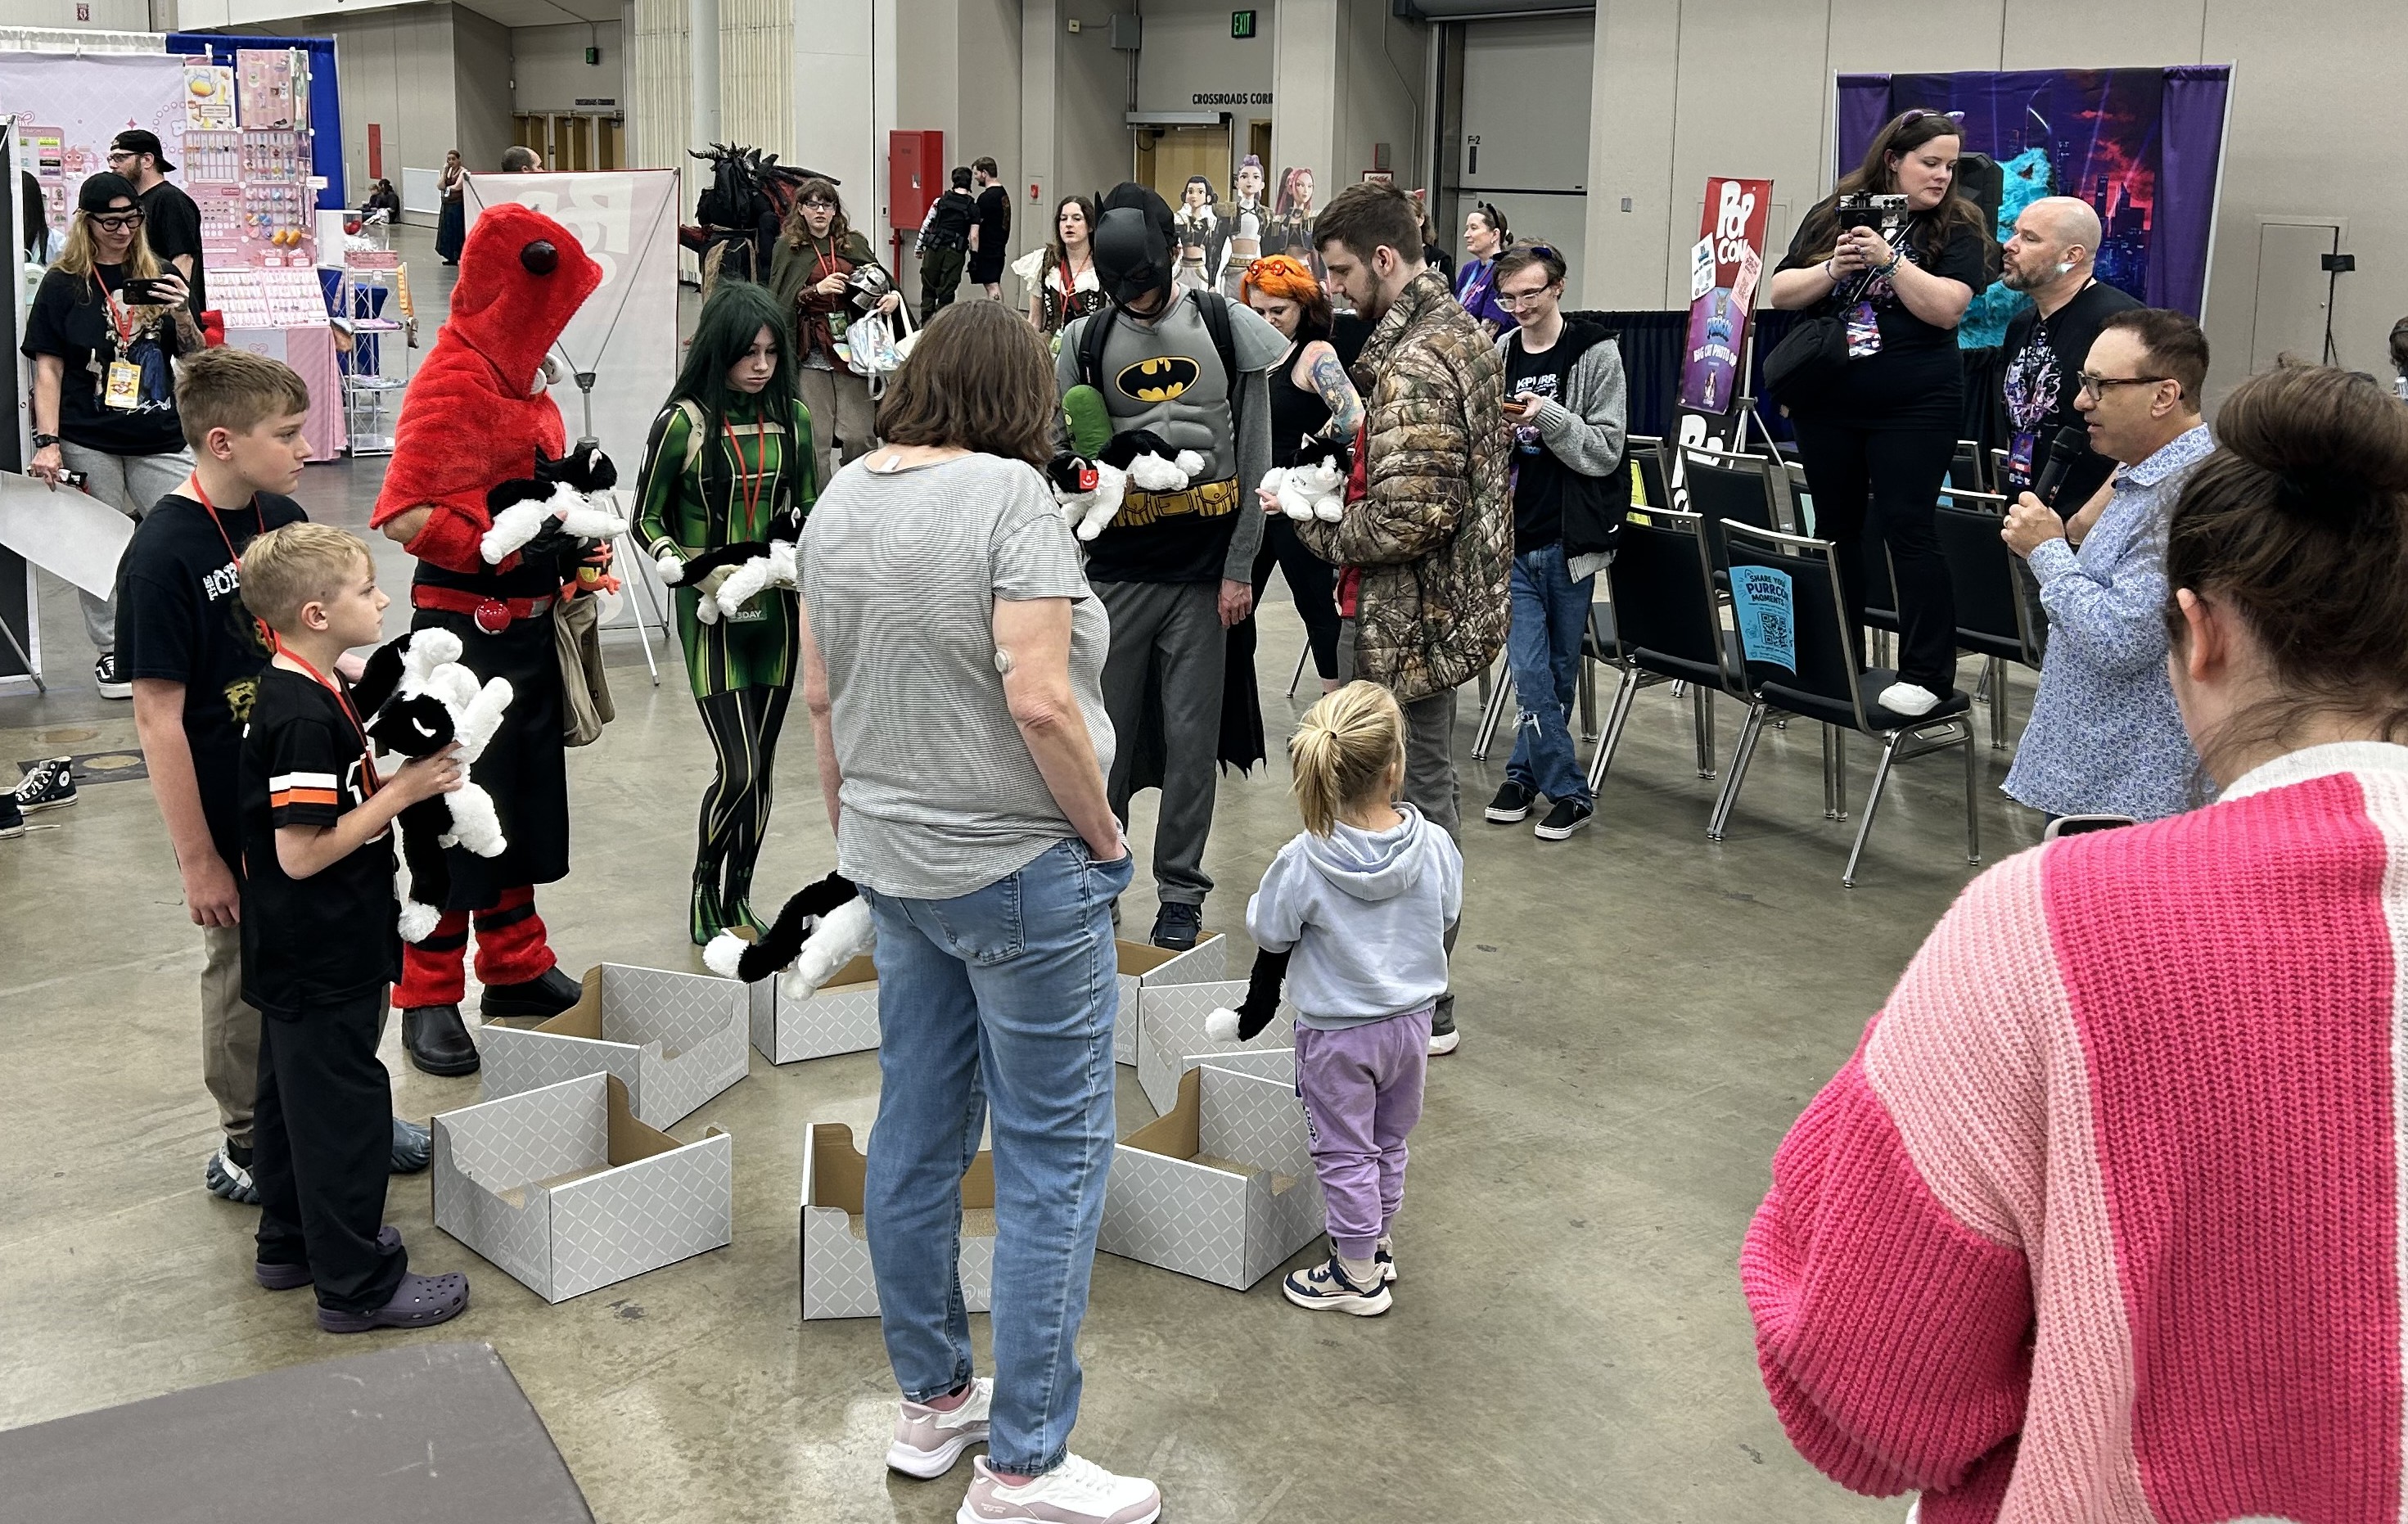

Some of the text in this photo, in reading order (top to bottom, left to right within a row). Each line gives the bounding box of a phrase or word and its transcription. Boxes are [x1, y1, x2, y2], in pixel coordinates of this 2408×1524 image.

[1234, 13, 1251, 35] EXIT
[1192, 93, 1248, 105] CROSSROADS
[1468, 135, 1481, 145] F-2
[1717, 237, 1749, 264] CON
[1750, 575, 1772, 584] SHARE
[1752, 593, 1785, 606] MOMENTS
